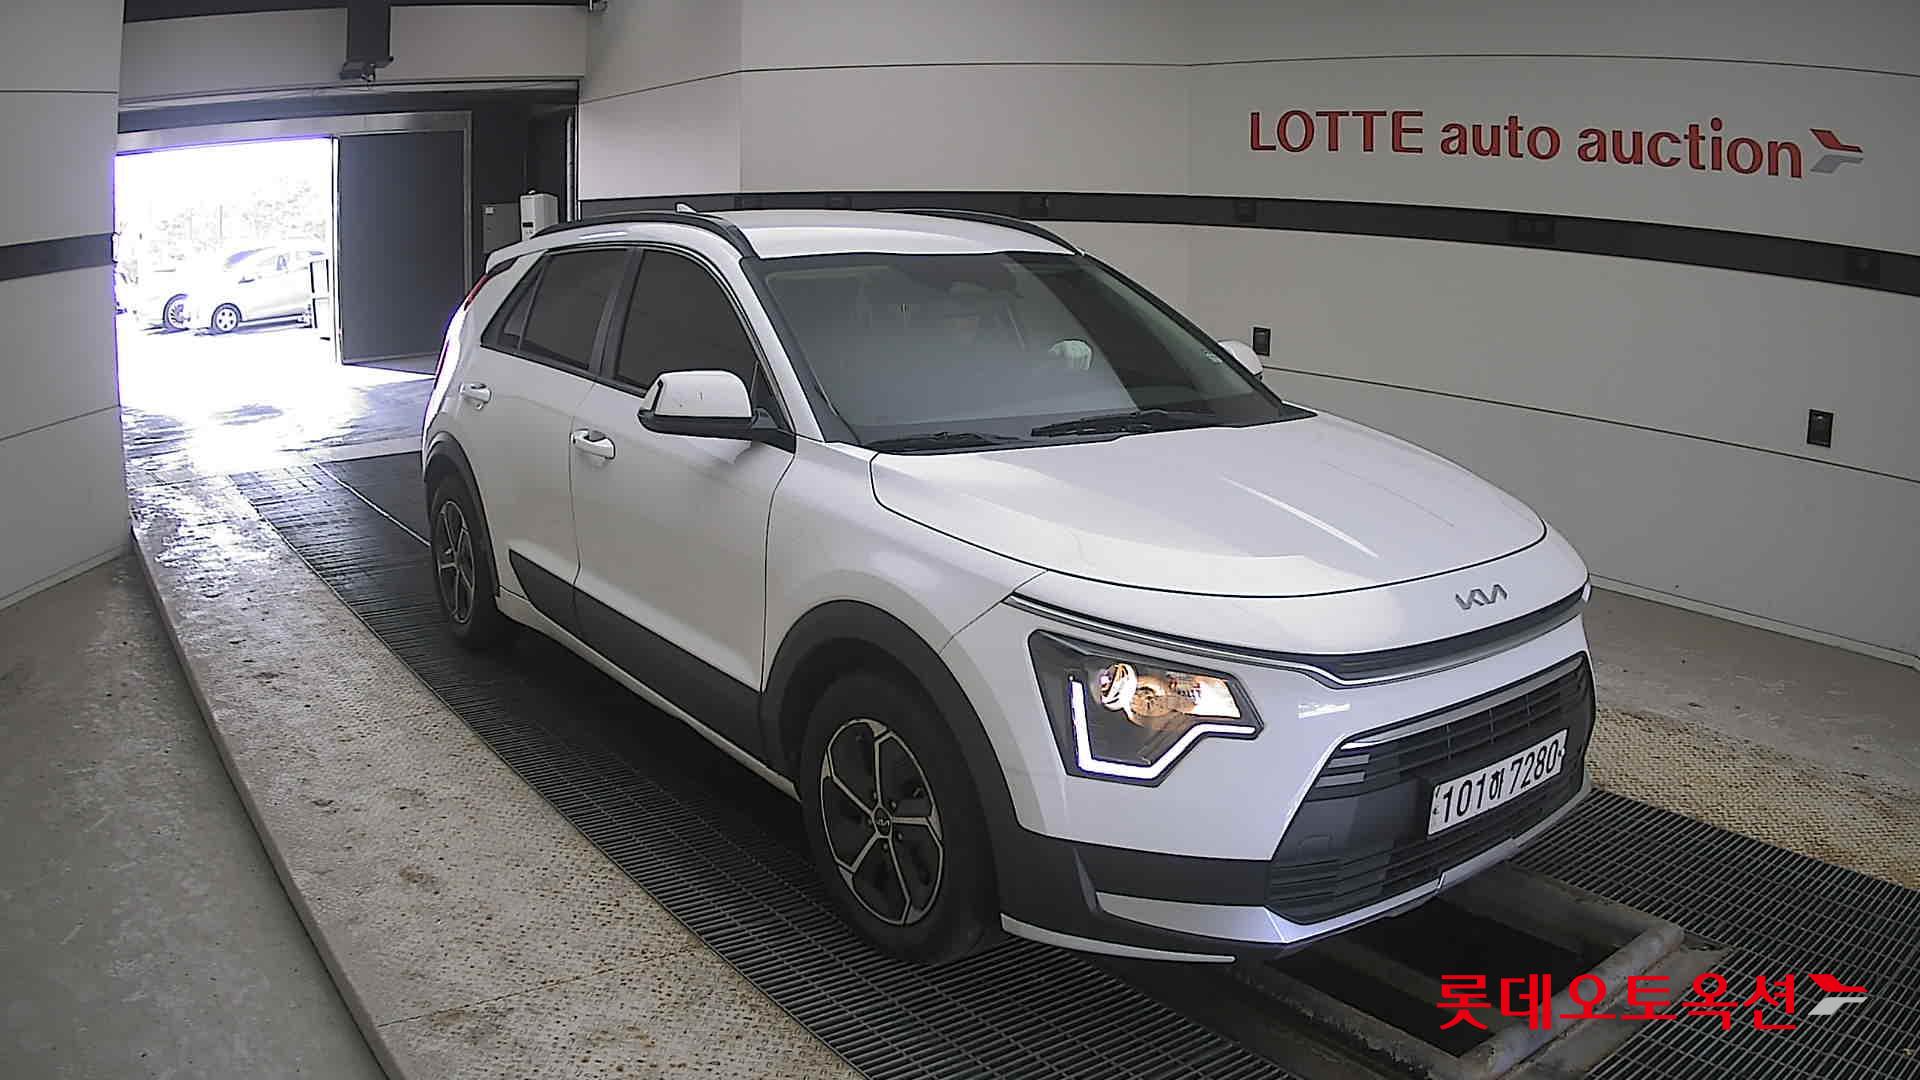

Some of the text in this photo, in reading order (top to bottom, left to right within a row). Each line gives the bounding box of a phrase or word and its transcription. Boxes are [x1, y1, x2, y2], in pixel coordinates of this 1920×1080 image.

[1250, 110, 1803, 178] LOTTE auto auction
[1509, 739, 1559, 794] 7280
